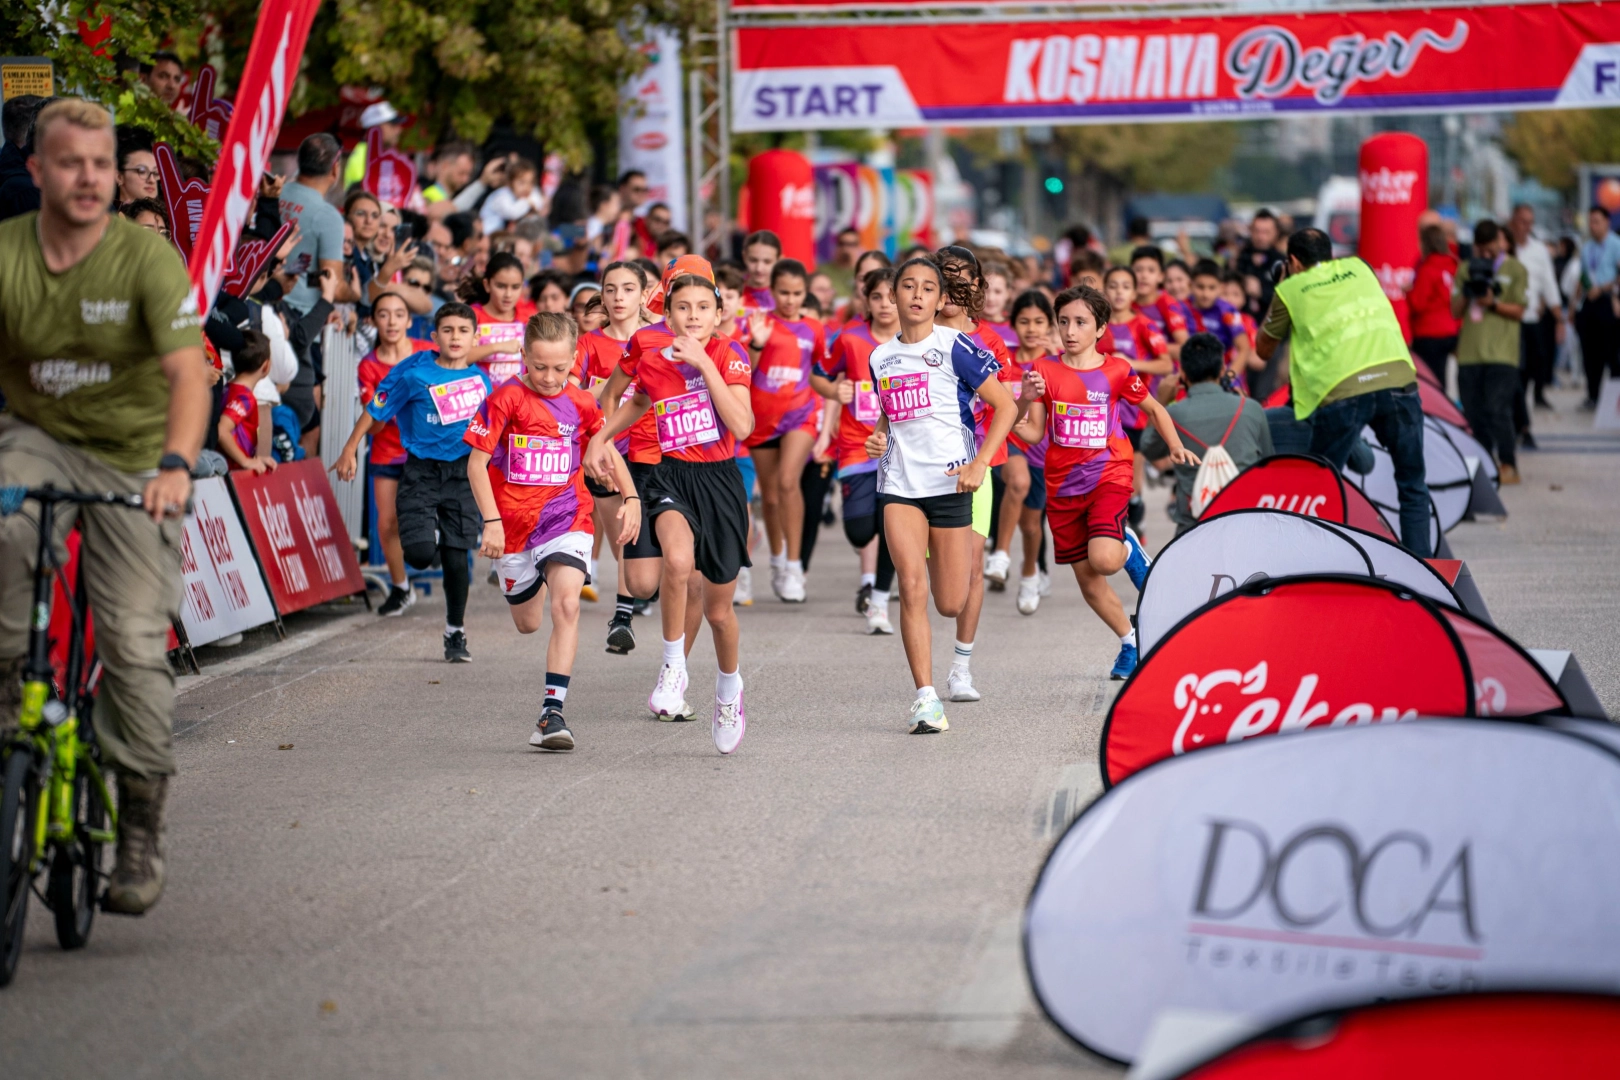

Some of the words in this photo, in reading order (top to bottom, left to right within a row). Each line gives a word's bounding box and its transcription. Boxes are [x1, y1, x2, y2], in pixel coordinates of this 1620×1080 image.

[1004, 34, 1219, 104] KOŞMAYA
[1225, 19, 1469, 105] Değer
[754, 84, 884, 118] START
[448, 388, 486, 411] 11051
[890, 387, 928, 411] 11018
[665, 407, 713, 437] 11029
[1064, 420, 1106, 437] 11059
[525, 452, 570, 472] 11010
[1226, 673, 1418, 744] ek
